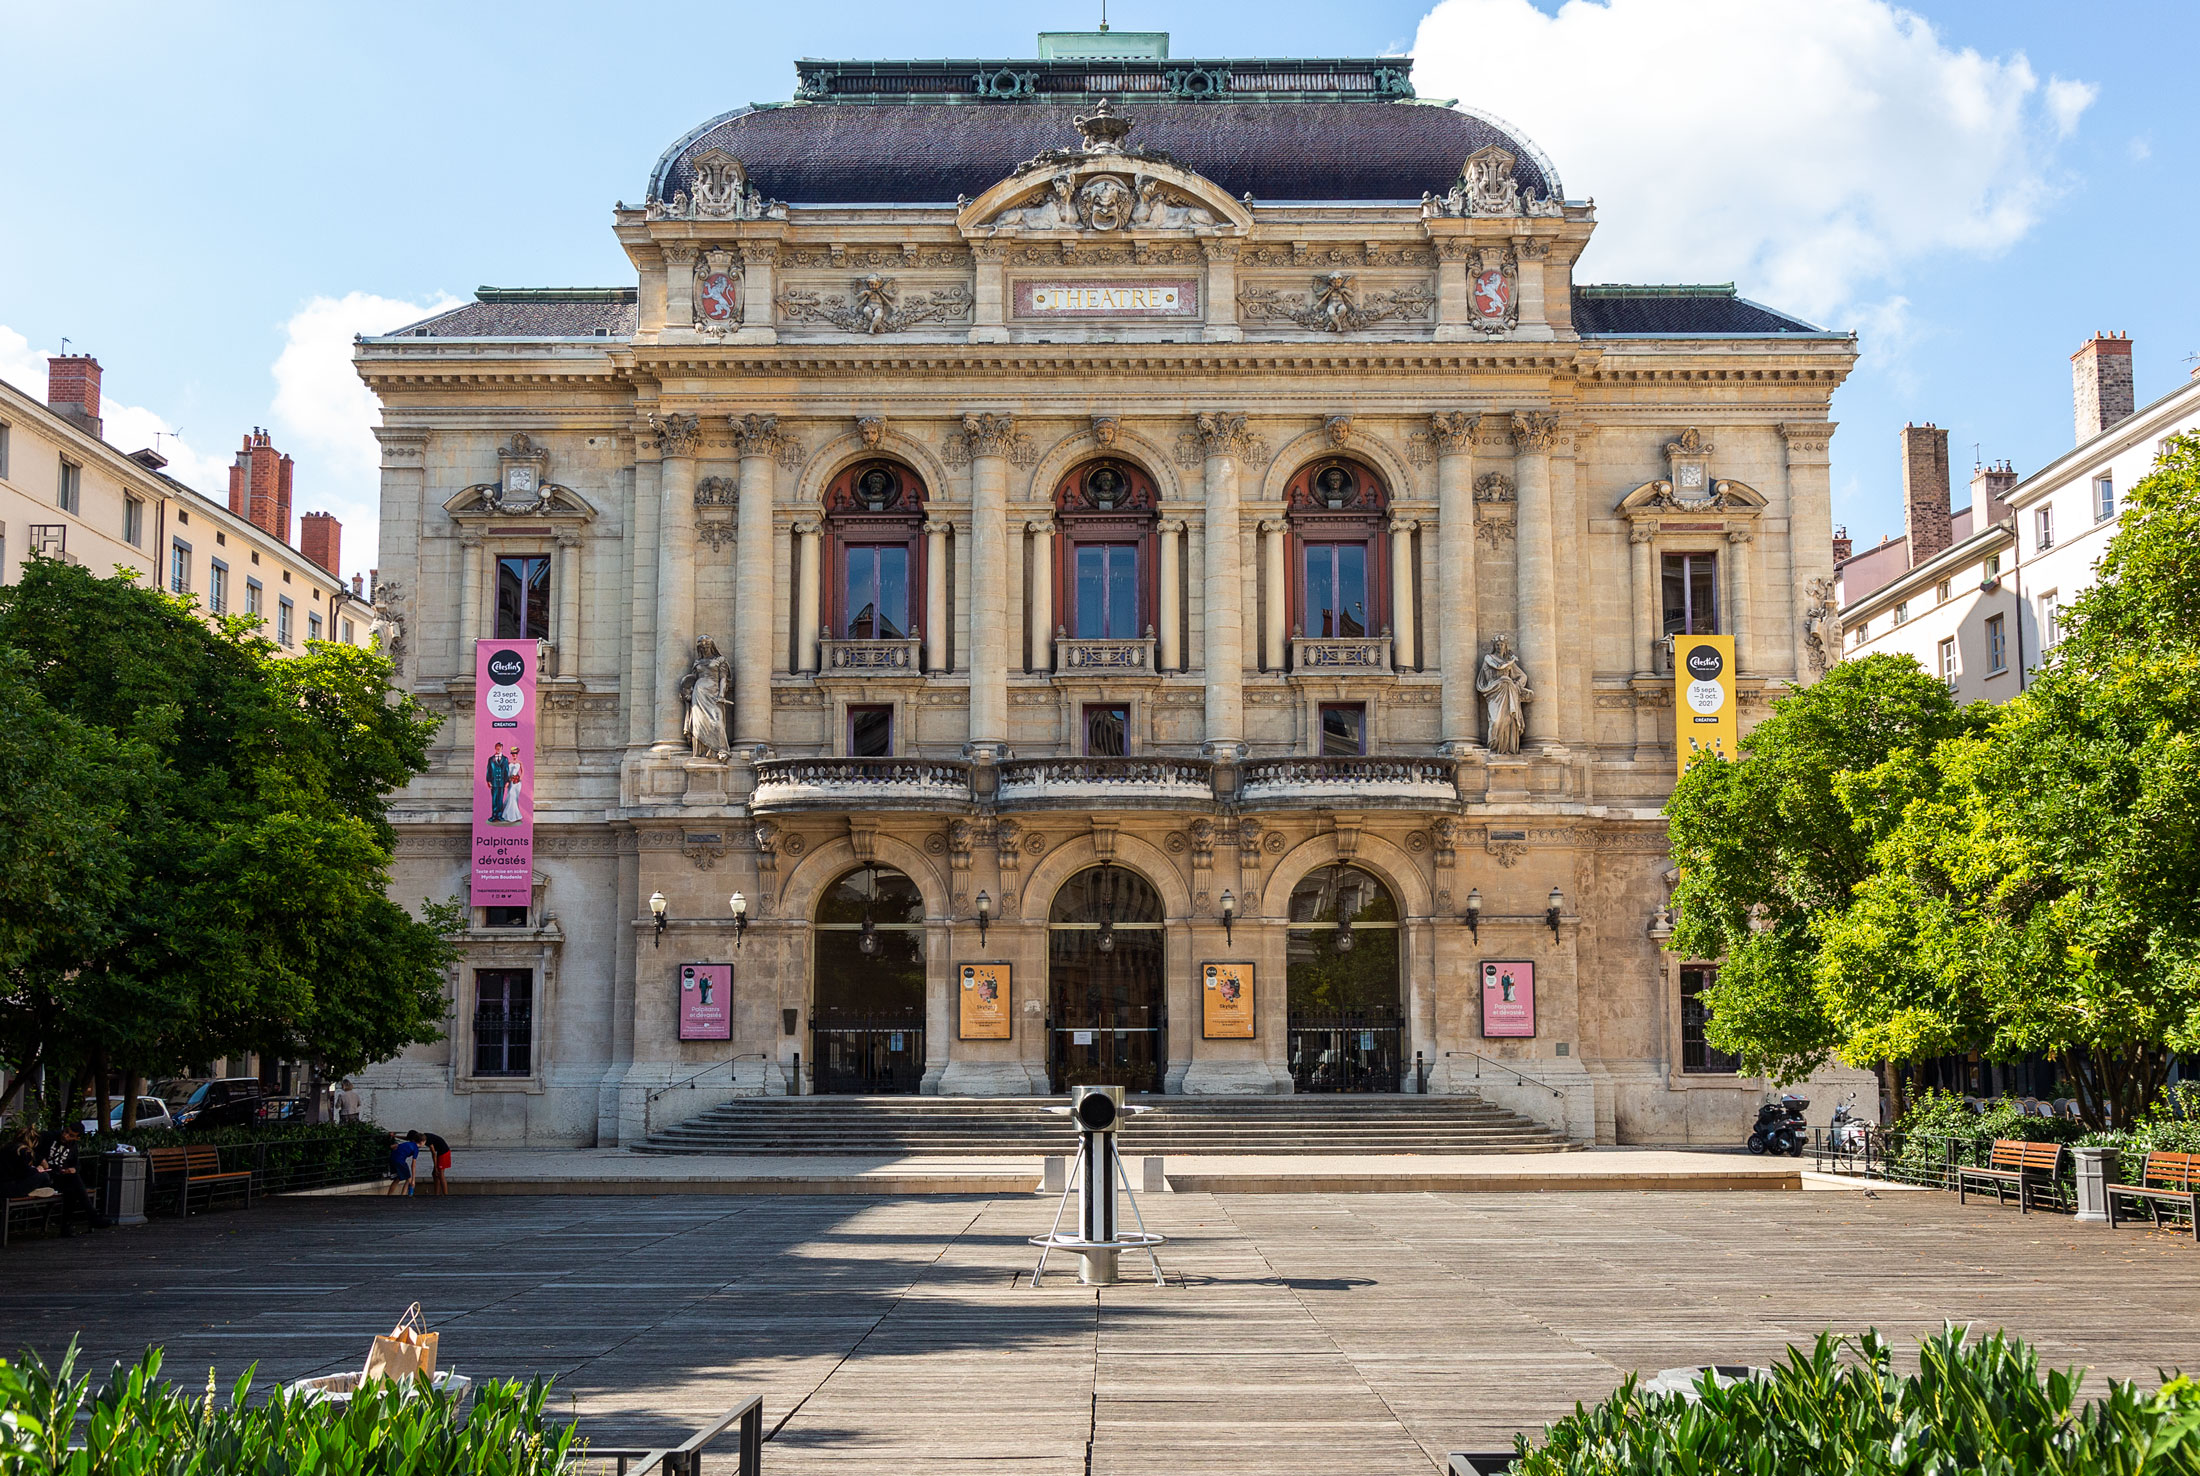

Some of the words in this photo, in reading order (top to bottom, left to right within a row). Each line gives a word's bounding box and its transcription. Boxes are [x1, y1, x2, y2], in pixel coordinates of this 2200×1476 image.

[1049, 289, 1162, 308] THEATRE
[1701, 686, 1718, 694] sept.
[502, 691, 518, 699] sept.
[476, 836, 529, 848] Palpitants
[497, 847, 508, 855] et
[478, 855, 526, 865] dévastés
